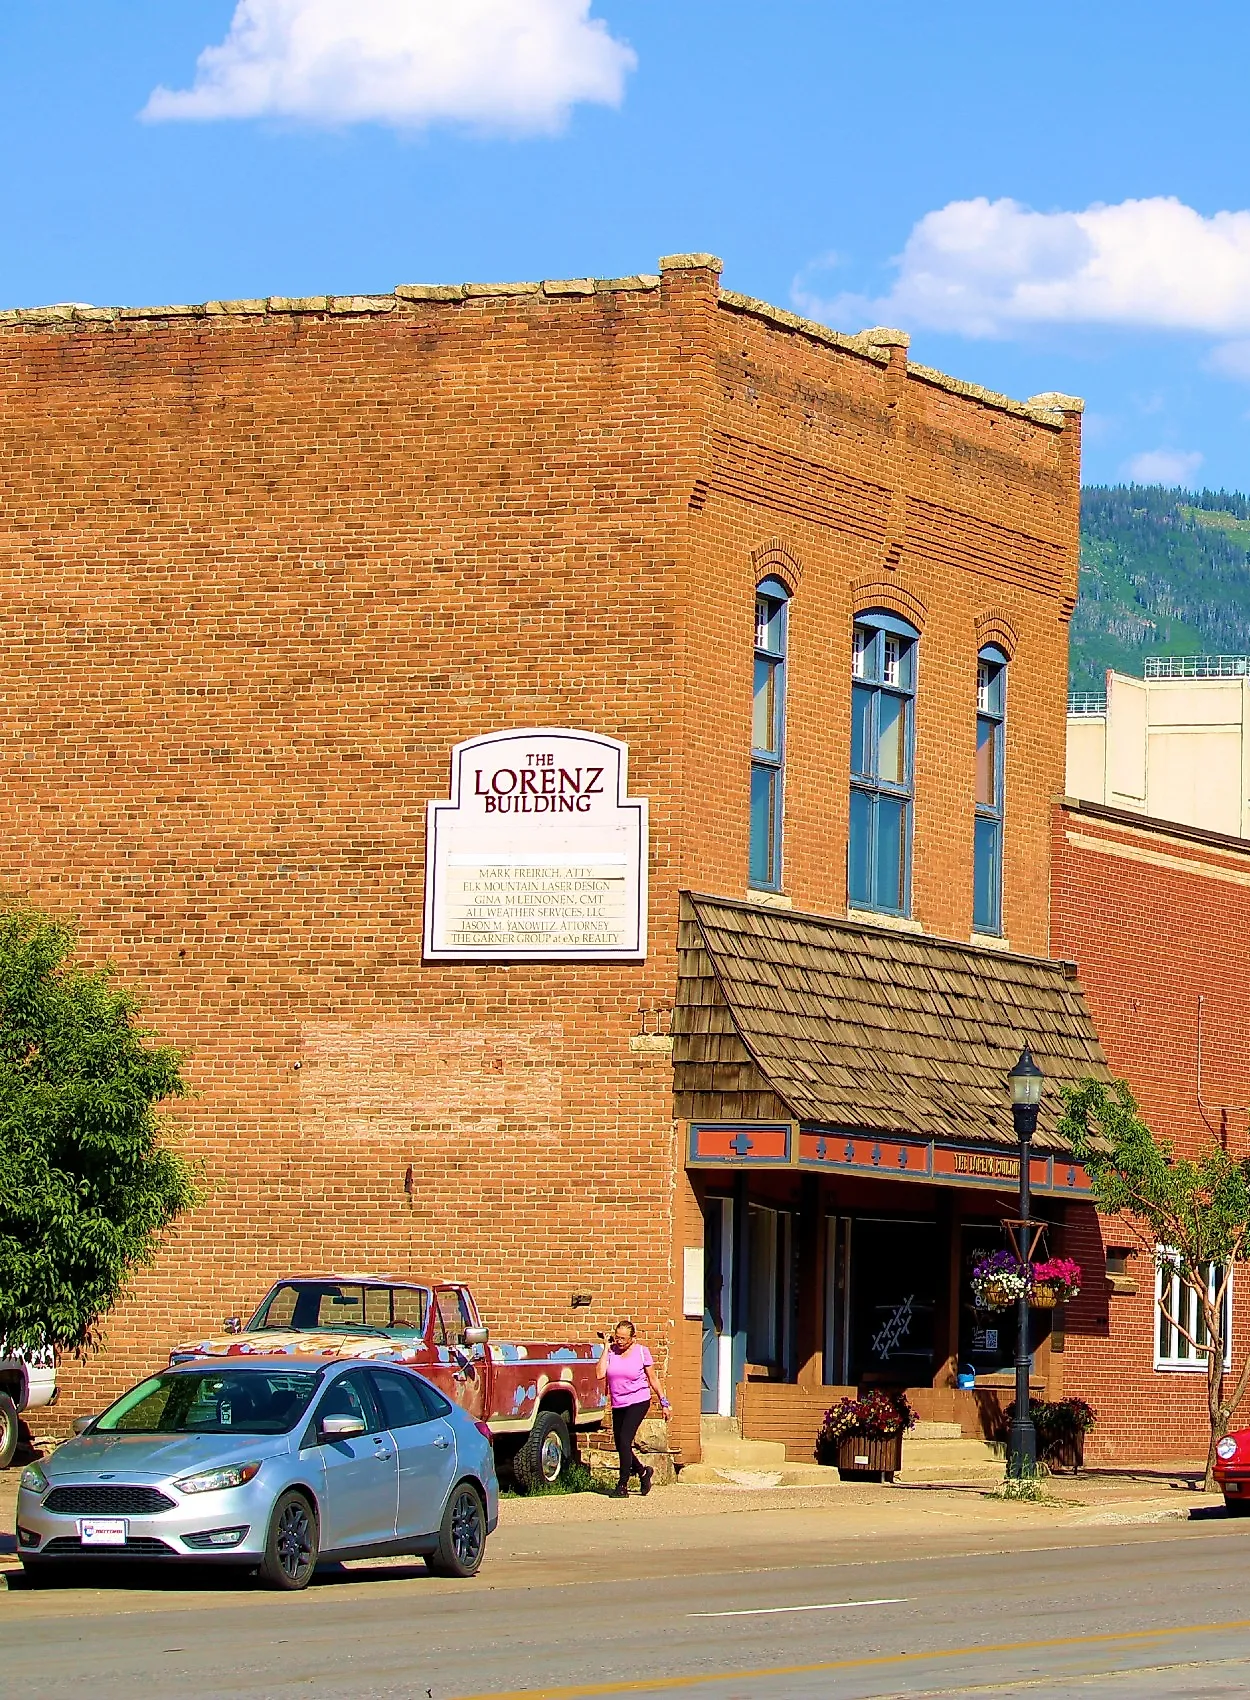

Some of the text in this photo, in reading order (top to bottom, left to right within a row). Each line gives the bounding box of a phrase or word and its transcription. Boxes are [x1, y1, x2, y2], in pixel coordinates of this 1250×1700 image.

[526, 754, 554, 766] THE
[474, 767, 605, 796] LORENZ
[484, 795, 592, 814] BUILDING
[479, 868, 511, 878] MARK
[463, 881, 611, 892] ELK MOUNTAIN LASER DESIGN
[474, 894, 501, 905] GINA
[579, 894, 604, 904] CMT
[466, 907, 484, 917] ALL
[487, 907, 535, 918] WEATHER
[586, 907, 606, 917] LLC
[462, 920, 491, 931] JASON
[560, 920, 609, 931] ATTORNEY
[451, 933, 471, 943] THE
[473, 933, 515, 943] GARNER
[516, 933, 551, 943] GROUP
[582, 933, 619, 943] REALTY
[954, 1152, 968, 1171] THE
